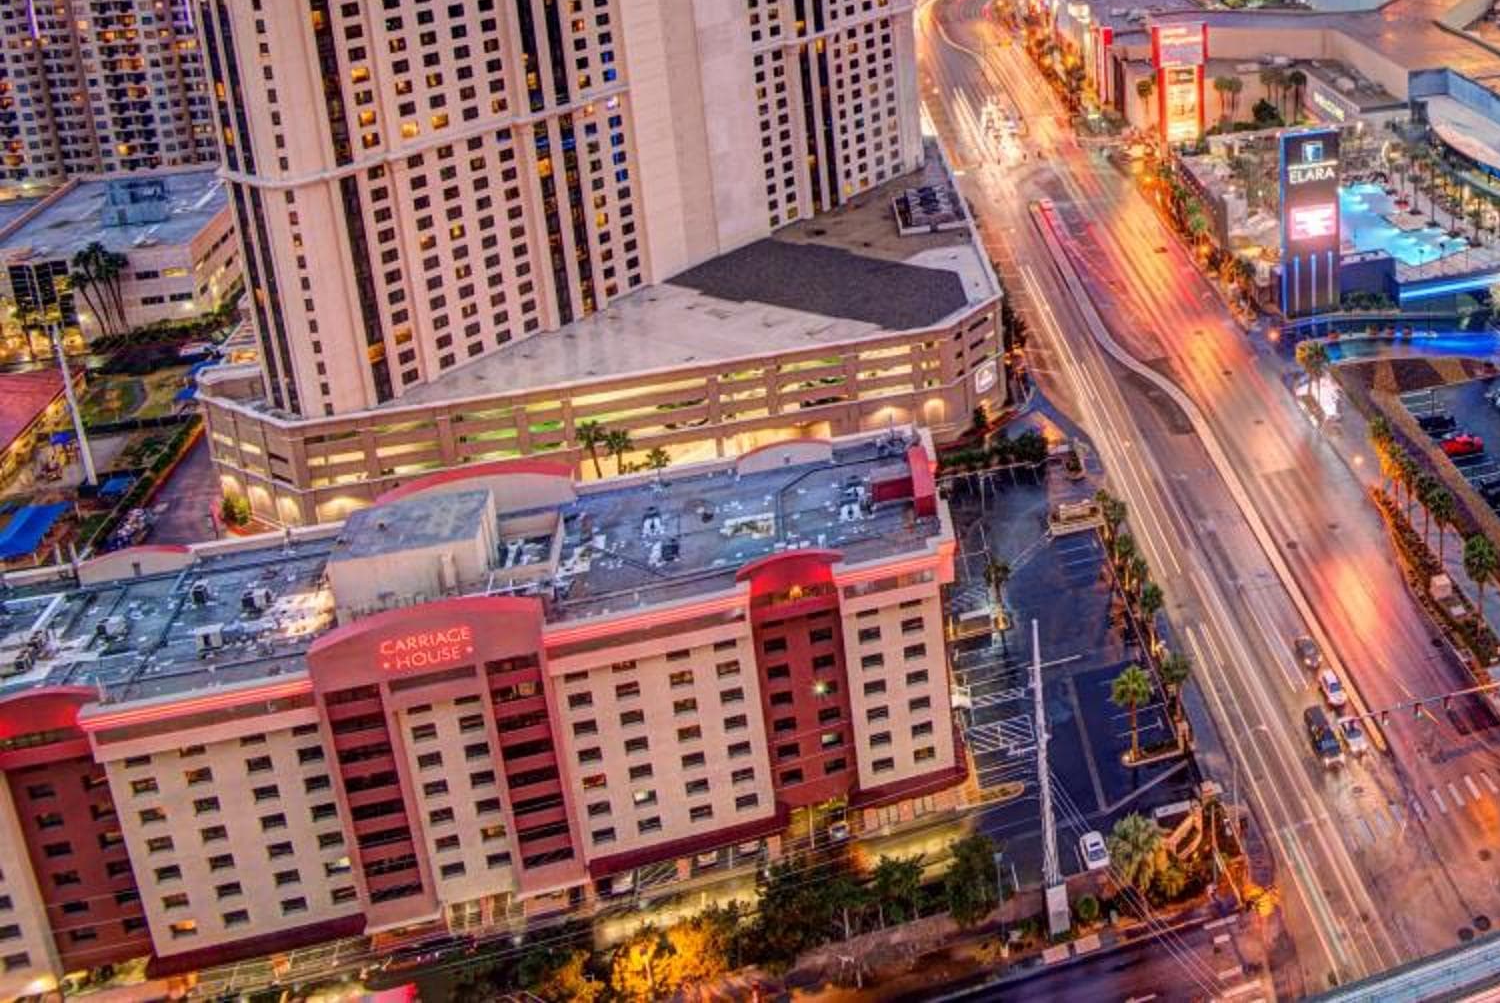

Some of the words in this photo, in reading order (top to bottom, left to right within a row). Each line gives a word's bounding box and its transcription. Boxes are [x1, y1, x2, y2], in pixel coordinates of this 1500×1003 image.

[1289, 166, 1336, 185] ELARA
[379, 625, 473, 655] CARRIAGE
[396, 647, 462, 669] HOUSE
